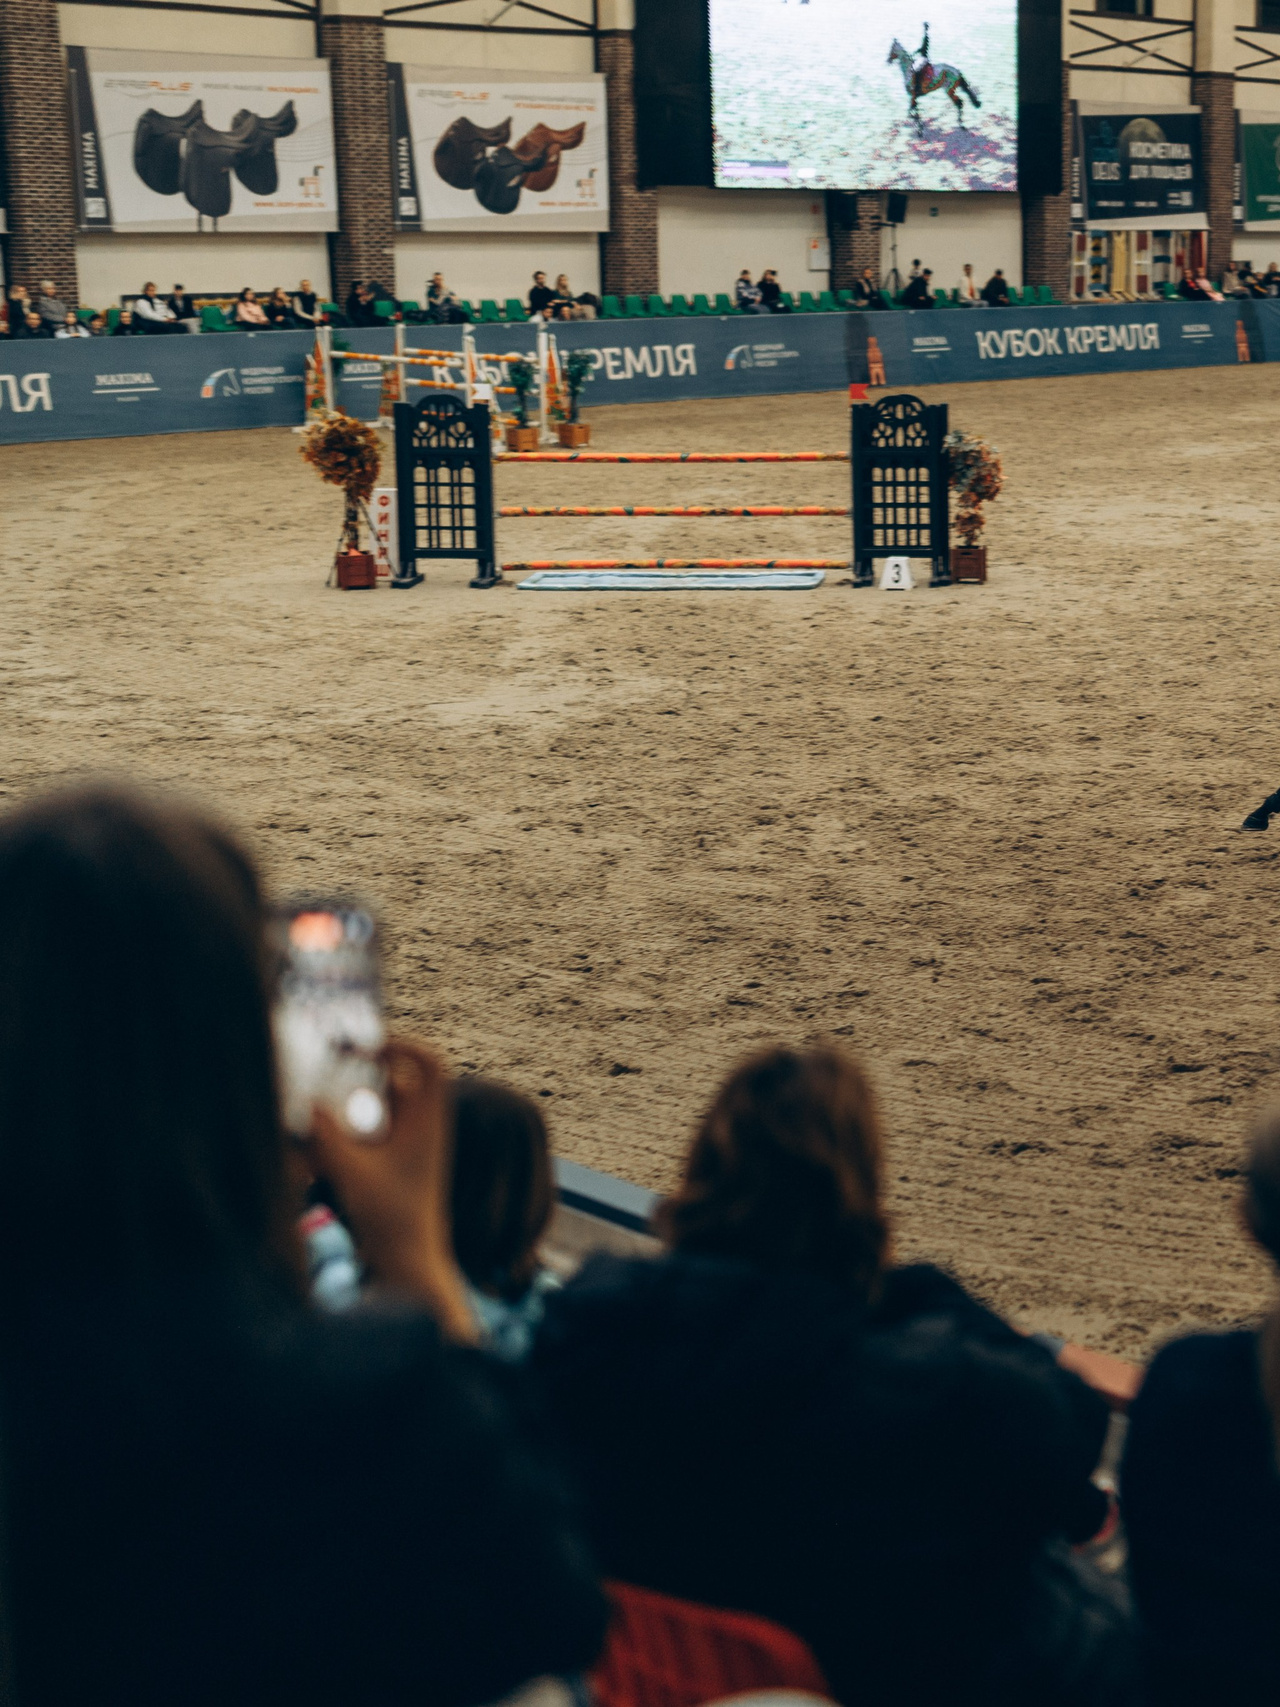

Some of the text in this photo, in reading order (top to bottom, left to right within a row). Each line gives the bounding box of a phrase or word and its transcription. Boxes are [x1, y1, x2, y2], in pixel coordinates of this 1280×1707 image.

[82, 131, 98, 189] MAXIMA
[397, 137, 411, 189] MAXIMA
[975, 322, 1160, 359] КУБОК КРЕМЛЯ
[891, 563, 902, 584] 3
